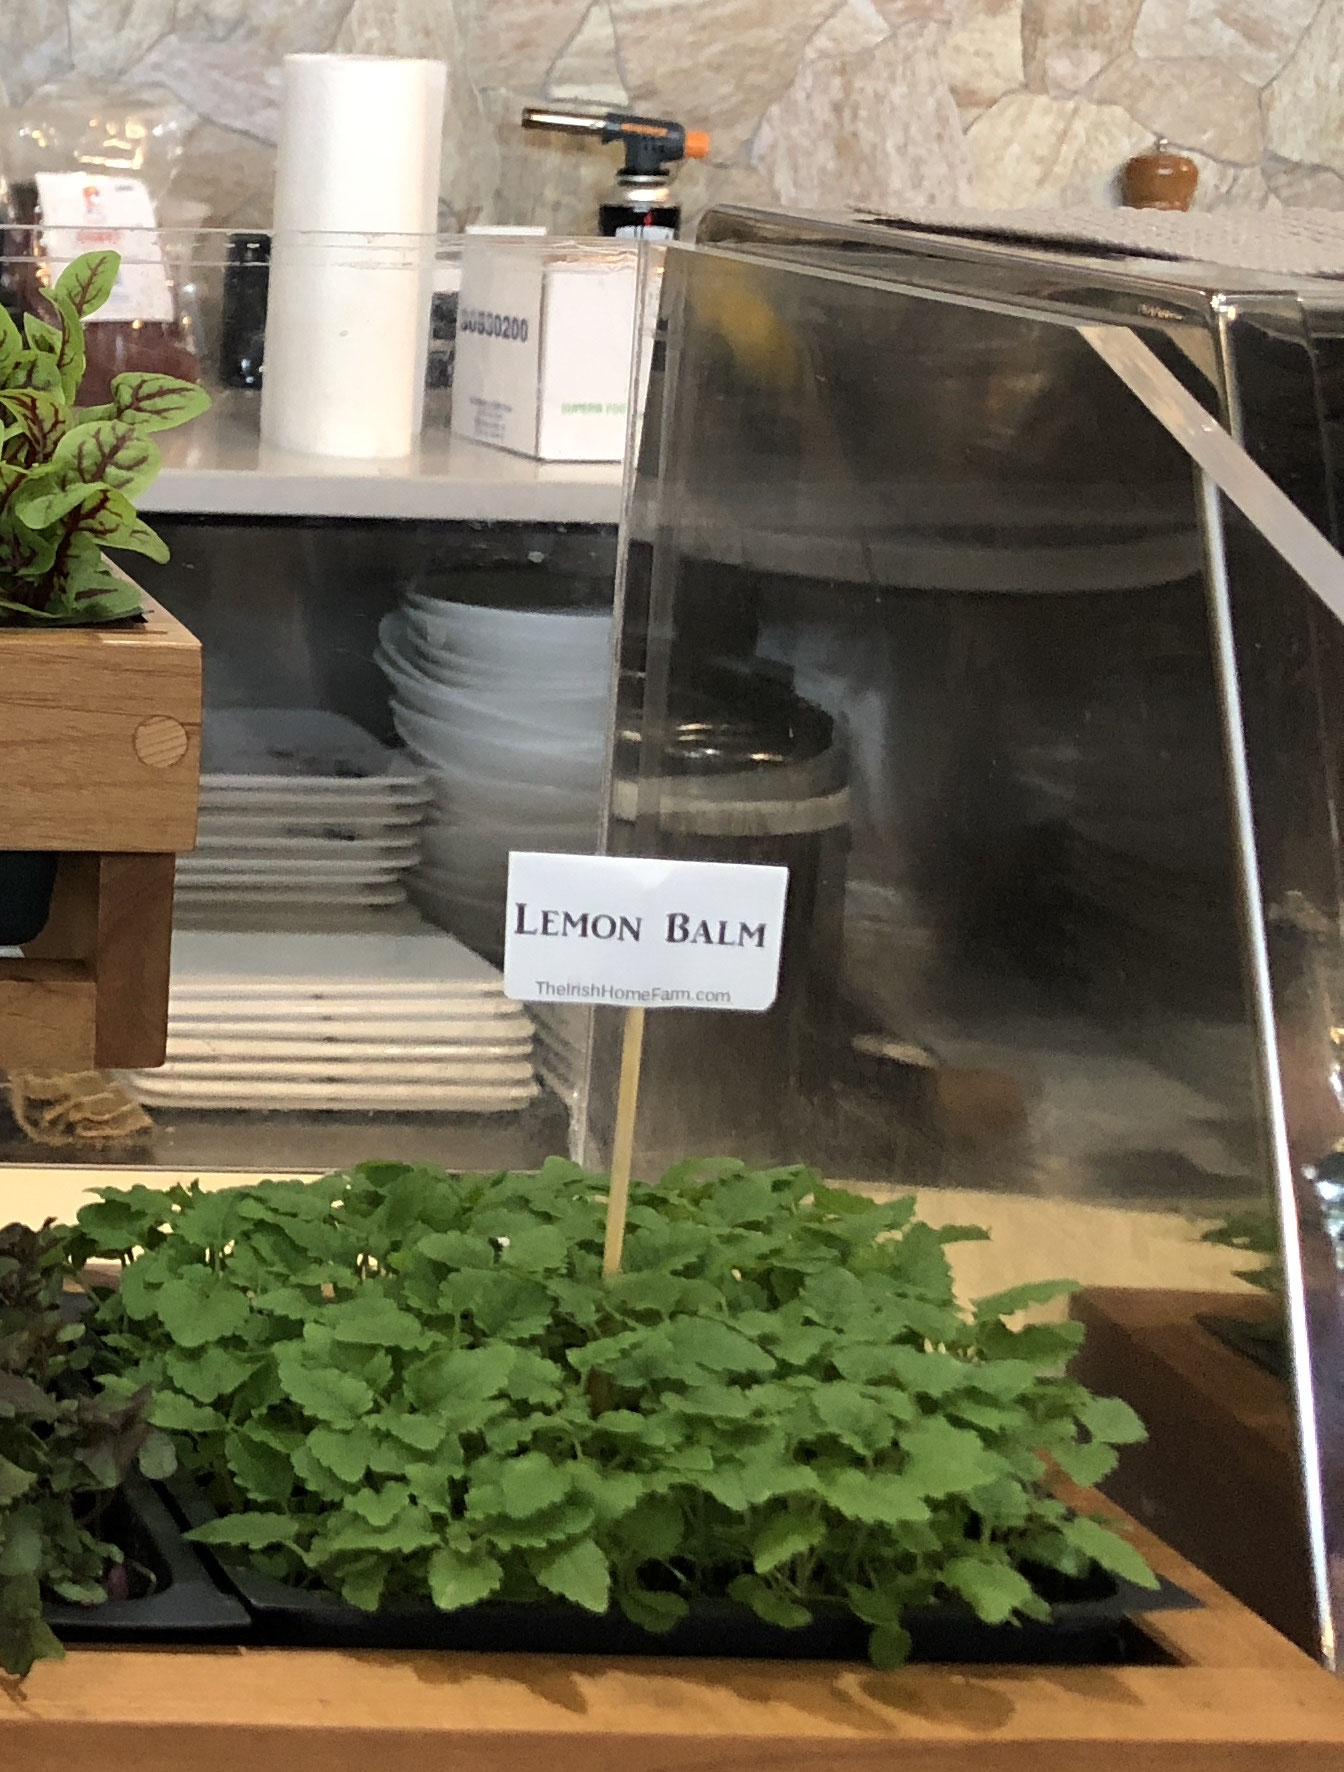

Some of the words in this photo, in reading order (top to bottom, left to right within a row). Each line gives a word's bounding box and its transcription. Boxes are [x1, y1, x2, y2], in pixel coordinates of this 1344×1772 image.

[513, 902, 643, 943] LEMON
[664, 912, 767, 949] BALM
[535, 980, 732, 1003] TheIrishHomeFarm.com
